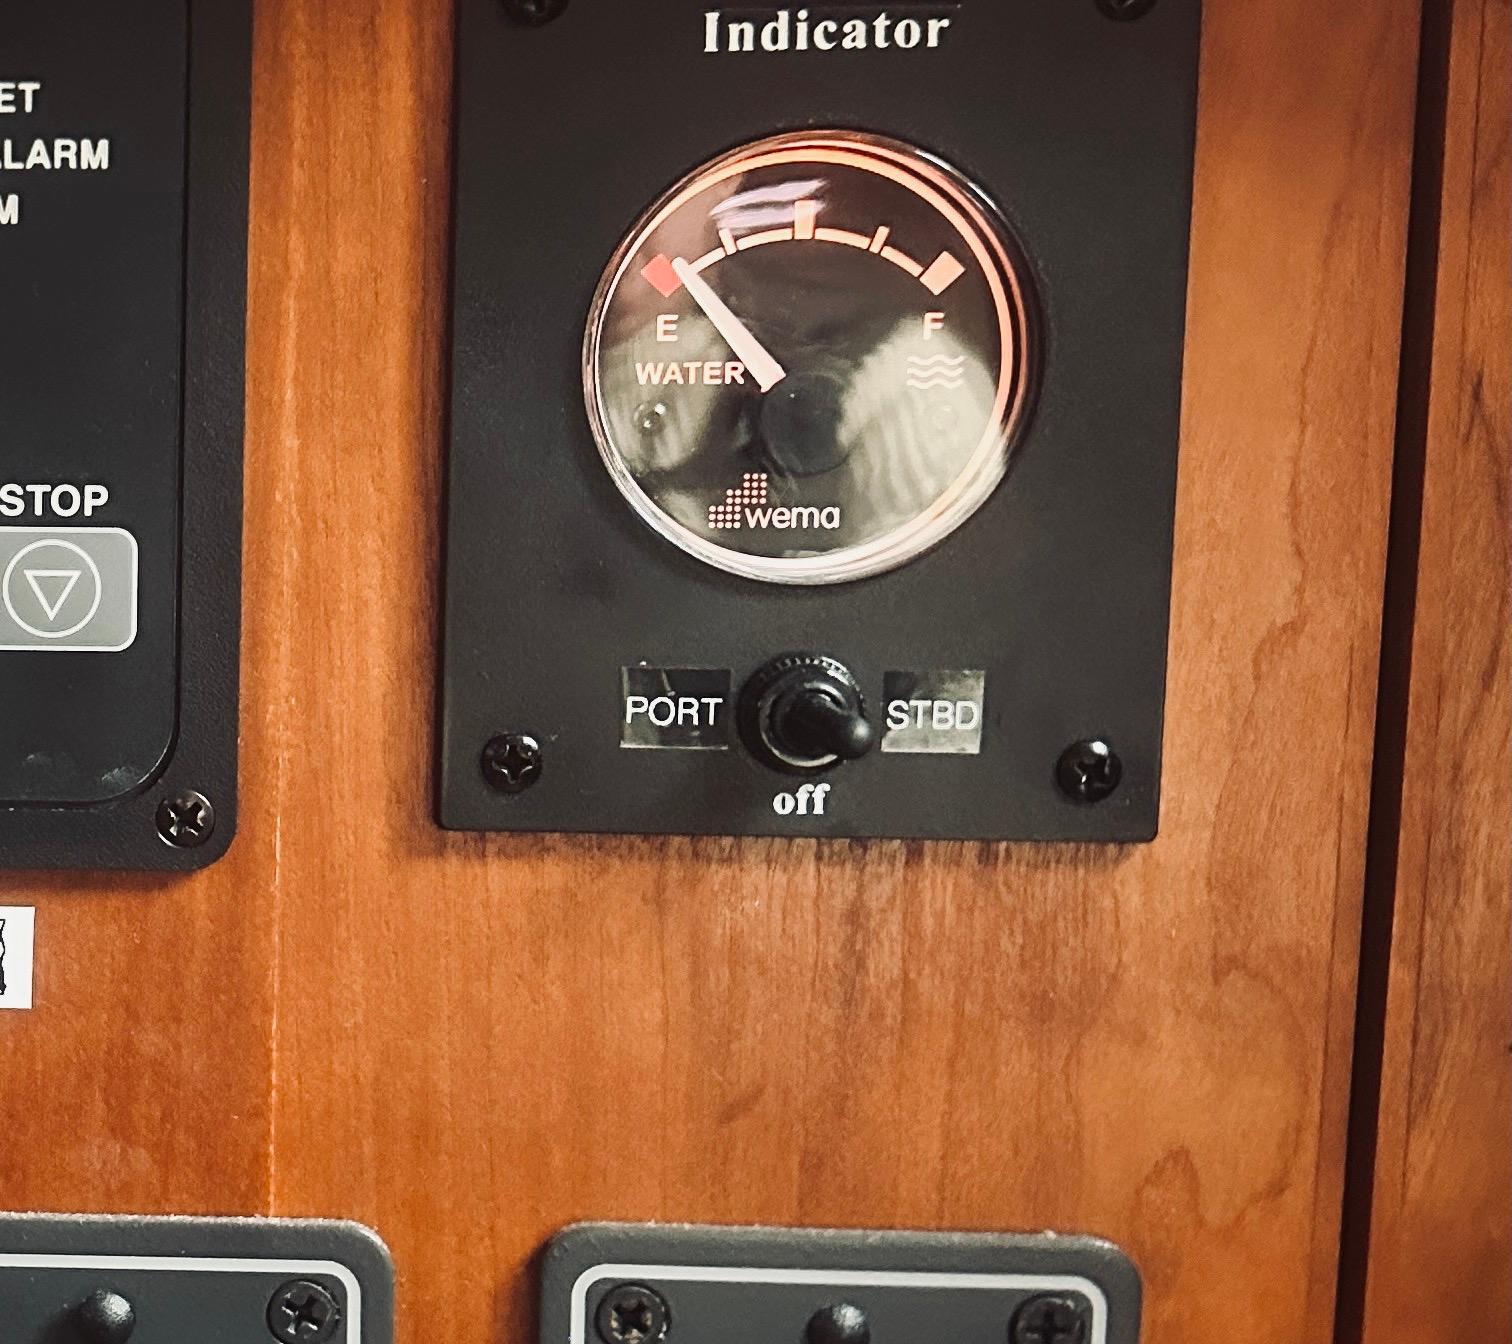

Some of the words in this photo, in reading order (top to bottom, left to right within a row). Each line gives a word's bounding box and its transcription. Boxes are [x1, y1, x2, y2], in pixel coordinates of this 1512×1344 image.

[703, 10, 950, 54] Indicator
[656, 314, 678, 341] E
[923, 312, 945, 340] F
[635, 361, 745, 385] WATER
[745, 506, 840, 528] wema
[625, 696, 723, 727] PORT
[886, 699, 980, 732] STBD
[773, 783, 832, 816] off
